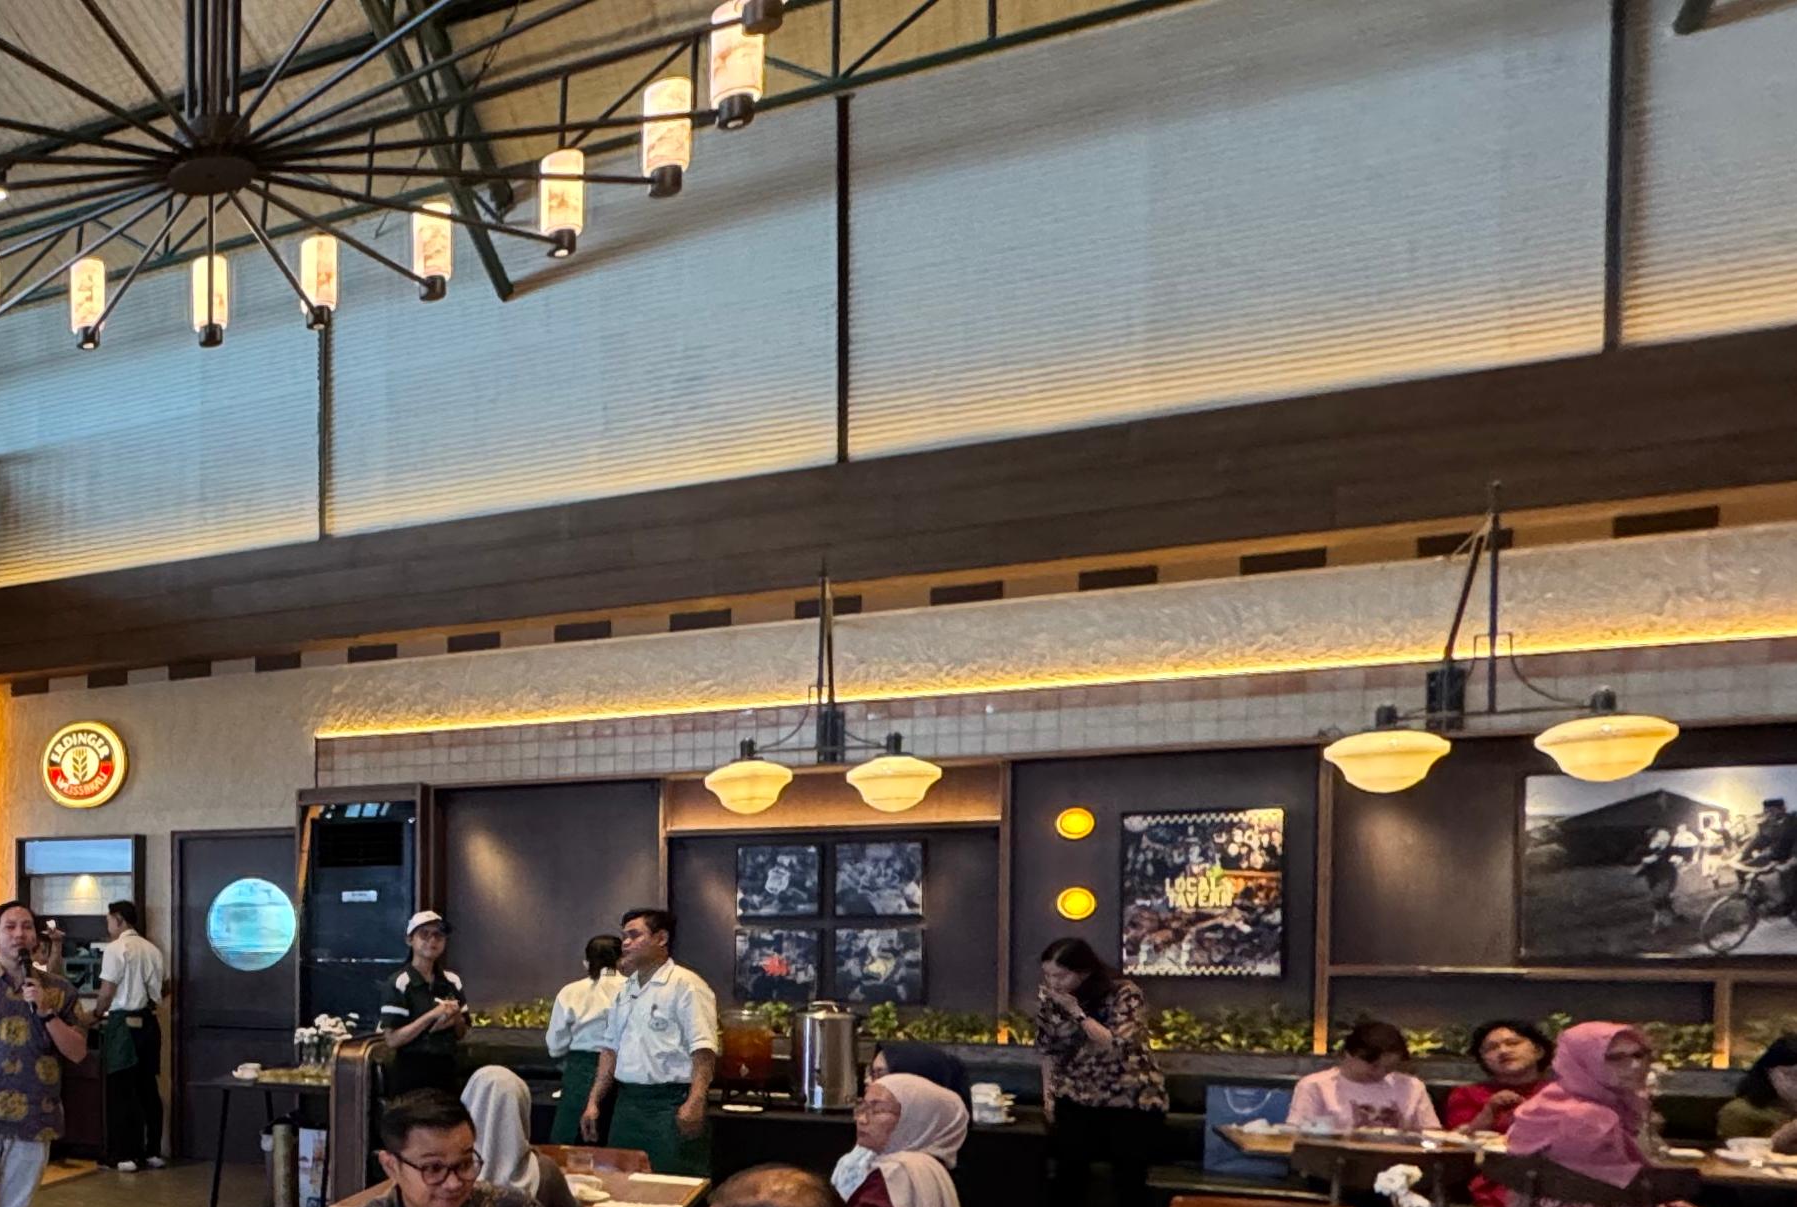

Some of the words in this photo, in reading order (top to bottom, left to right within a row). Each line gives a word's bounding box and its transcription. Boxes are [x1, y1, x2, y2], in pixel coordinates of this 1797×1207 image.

[51, 732, 110, 763] ERDINGER
[1164, 875, 1219, 893] LOCAL
[1168, 891, 1234, 908] TAVERN
